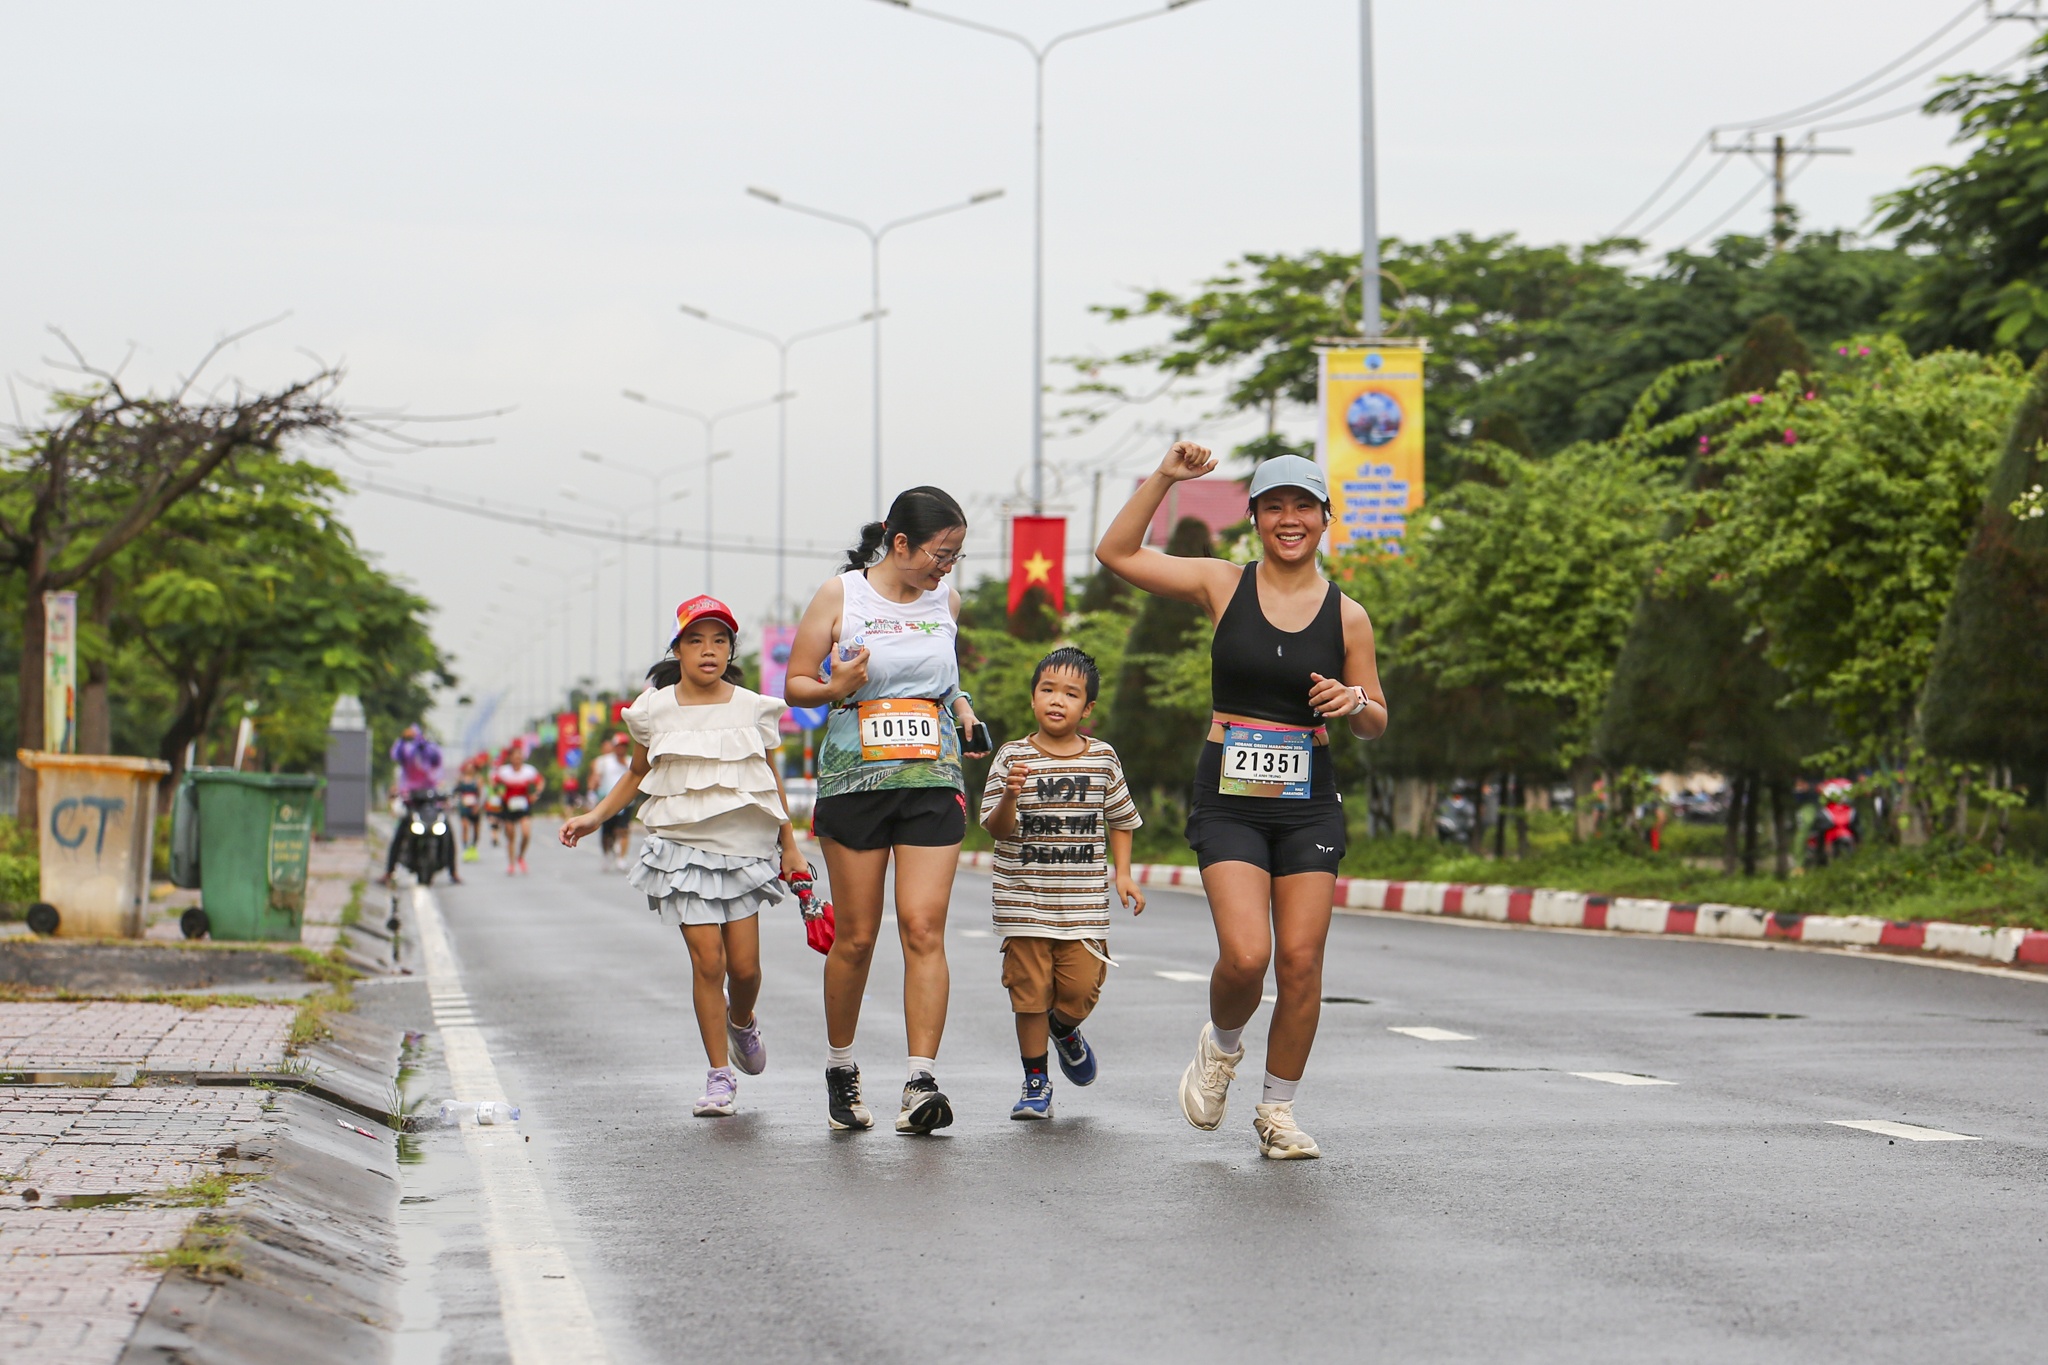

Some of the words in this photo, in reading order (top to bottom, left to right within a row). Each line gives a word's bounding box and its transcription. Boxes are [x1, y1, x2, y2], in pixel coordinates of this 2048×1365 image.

[871, 719, 930, 738] 10150
[919, 748, 937, 756] 10KM
[1235, 750, 1299, 774] 21351
[1037, 775, 1091, 802] NOT
[52, 796, 126, 856] CT
[1021, 814, 1062, 836] FOR
